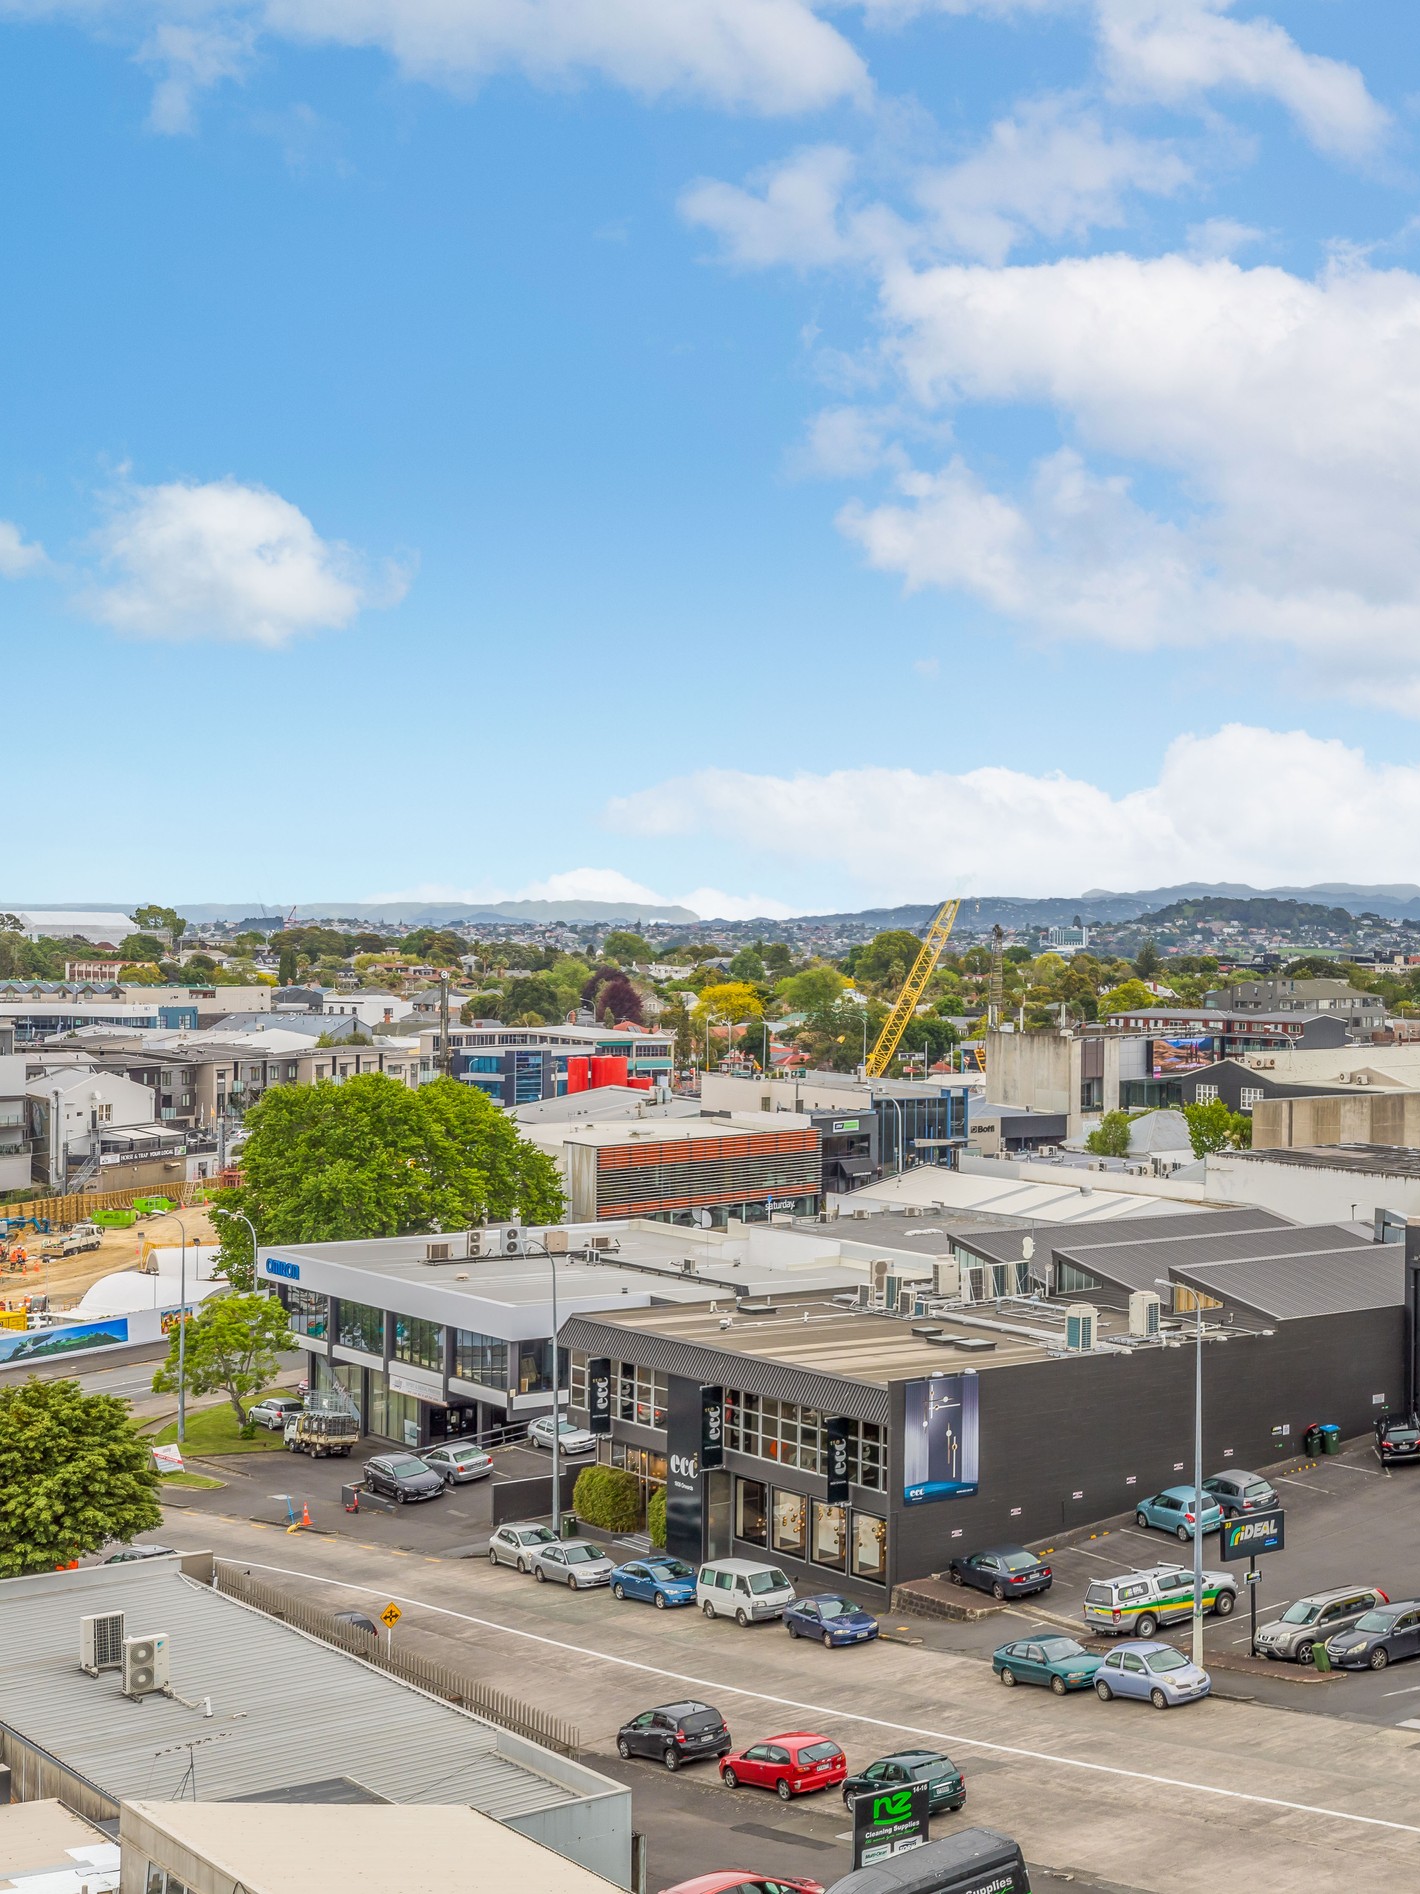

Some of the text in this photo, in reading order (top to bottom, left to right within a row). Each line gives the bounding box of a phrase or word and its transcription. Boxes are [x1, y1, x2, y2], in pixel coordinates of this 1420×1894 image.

[121, 1153, 134, 1161] HORSE
[150, 1150, 161, 1158] YOUR
[161, 1149, 174, 1157] LOCAL
[266, 1257, 299, 1280] OMRON
[670, 1453, 698, 1479] ecc
[865, 1826, 893, 1839] Cleaning
[893, 1820, 920, 1832] Supplies
